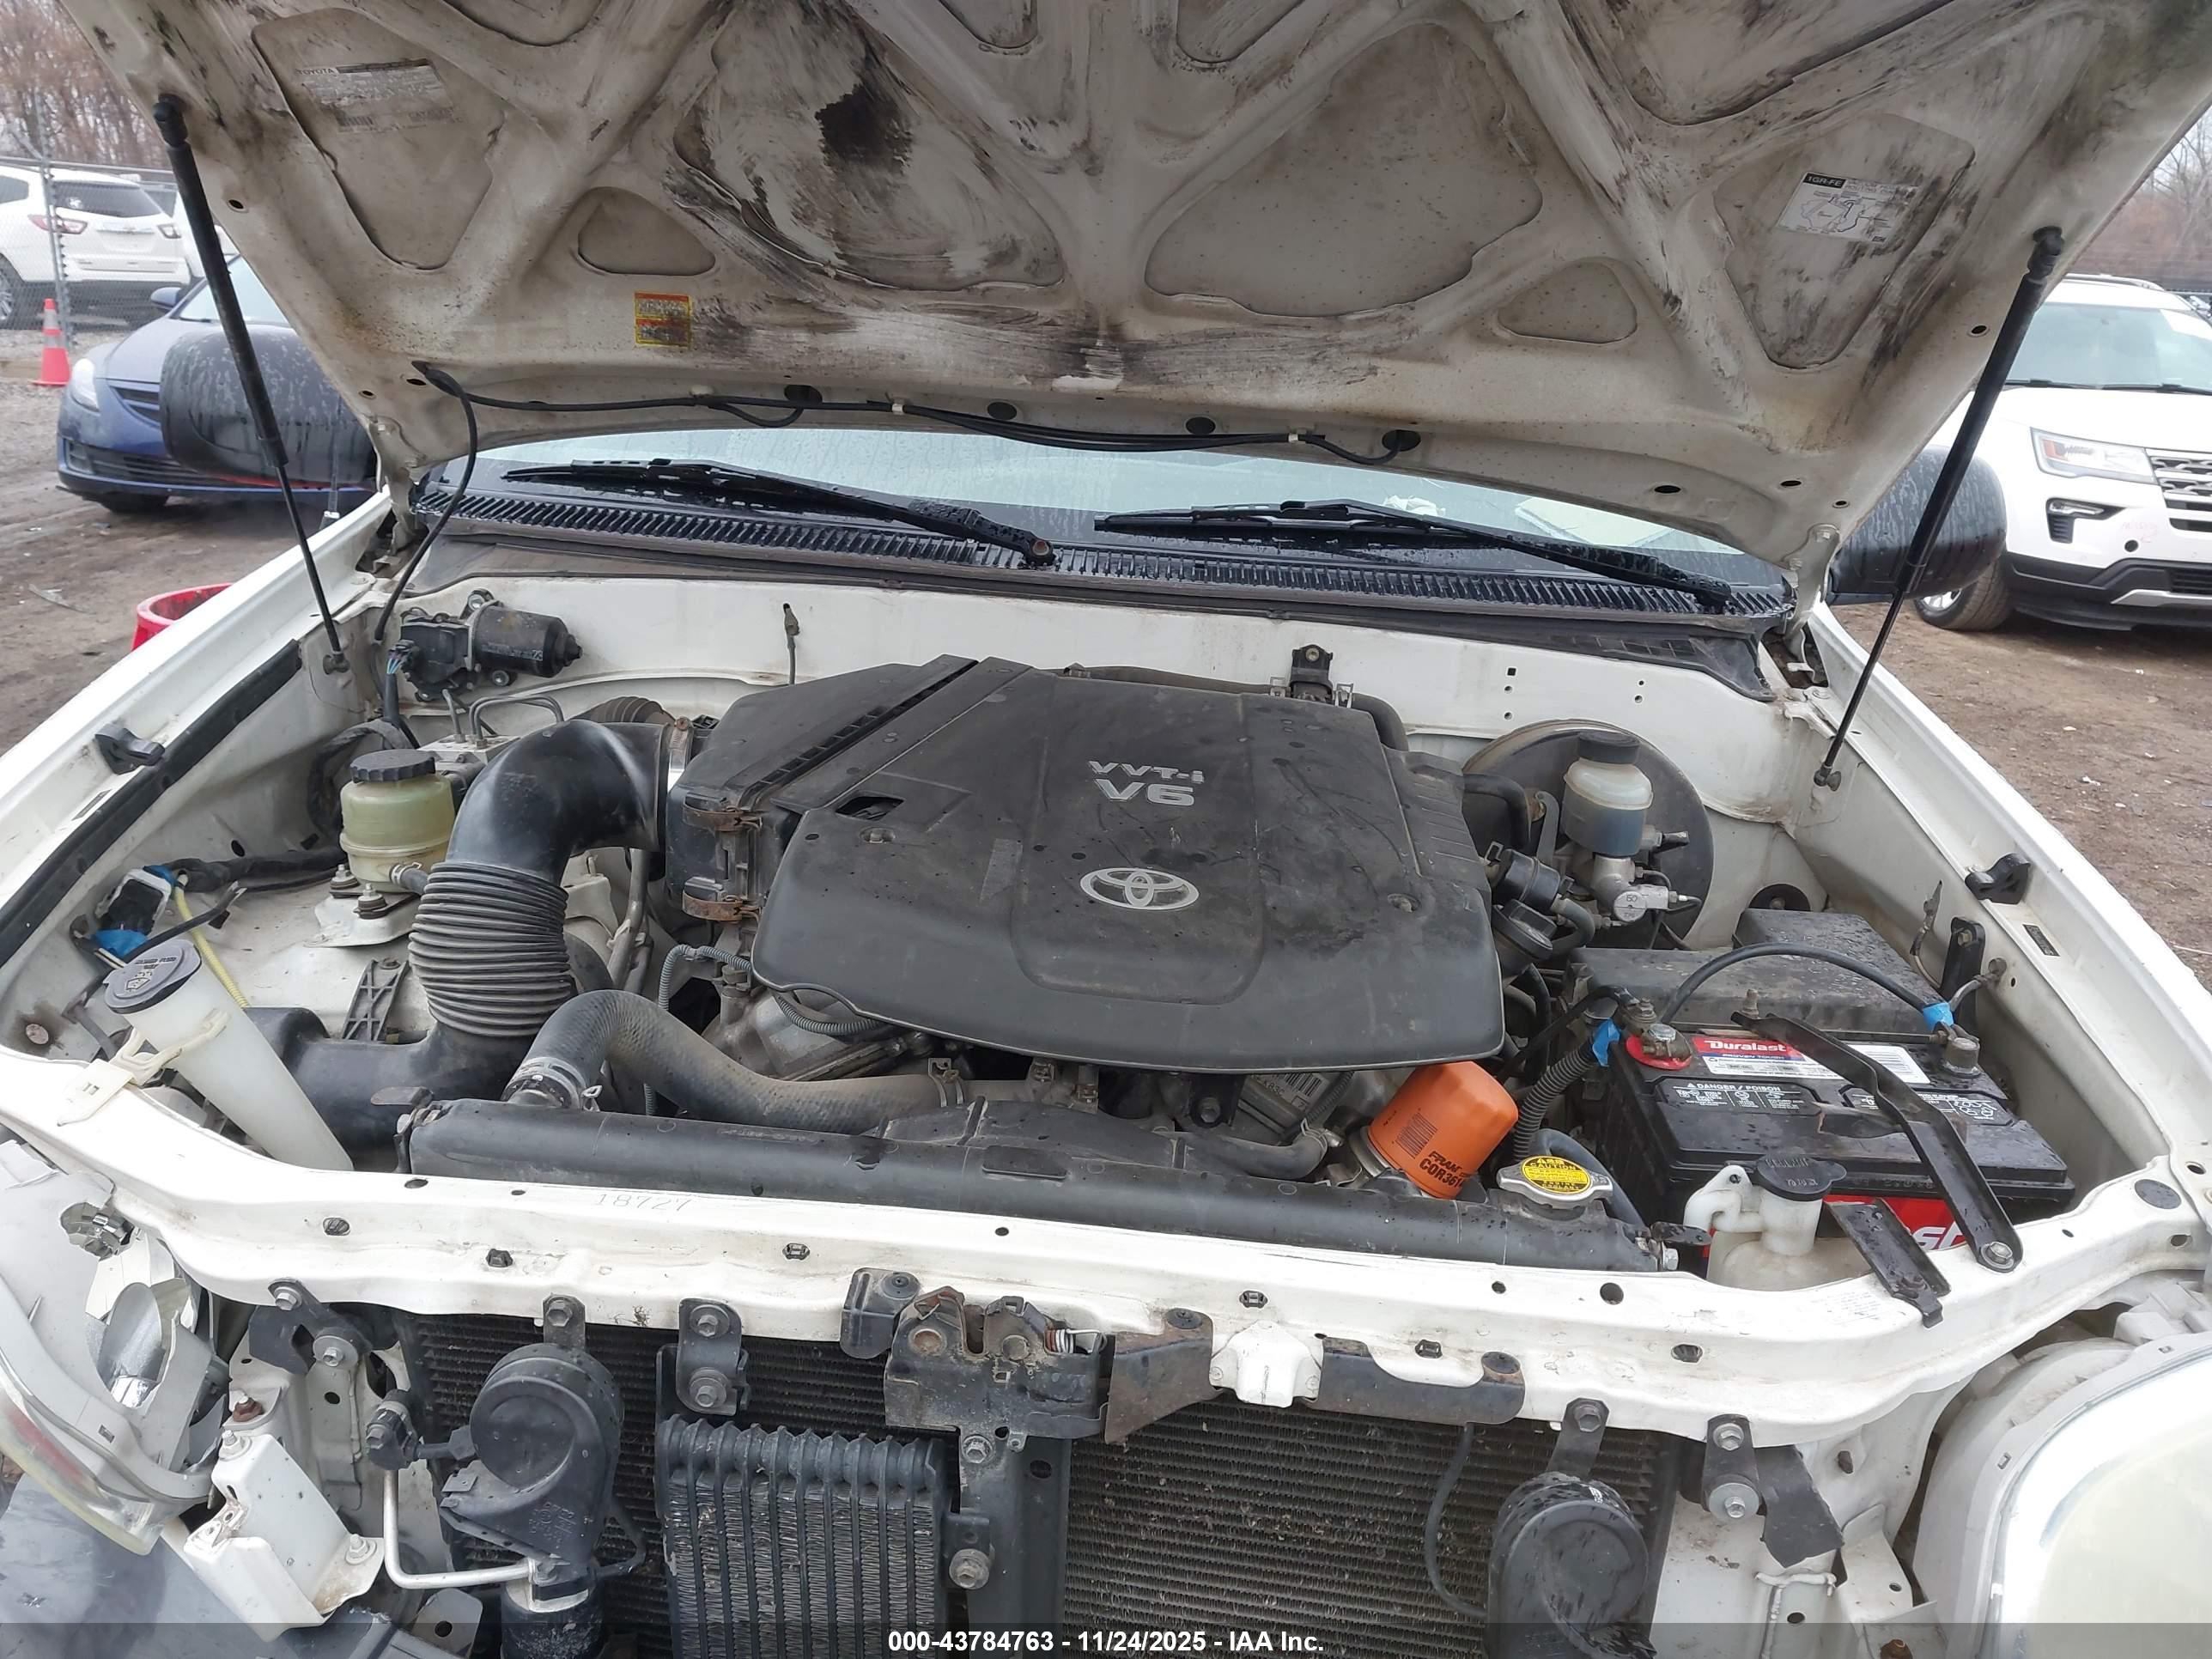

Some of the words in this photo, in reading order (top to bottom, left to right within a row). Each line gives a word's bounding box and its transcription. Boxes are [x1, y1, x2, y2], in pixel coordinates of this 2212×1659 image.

[1808, 176, 1842, 186] 1GR-FE
[1088, 761, 1205, 784] VVT-i
[1094, 778, 1194, 806] V6
[1704, 1040, 1787, 1052] Duralast
[1419, 1158, 1463, 1188] COR361
[1428, 1151, 1462, 1173] FRAM
[1530, 1162, 1577, 1170] CAUTION
